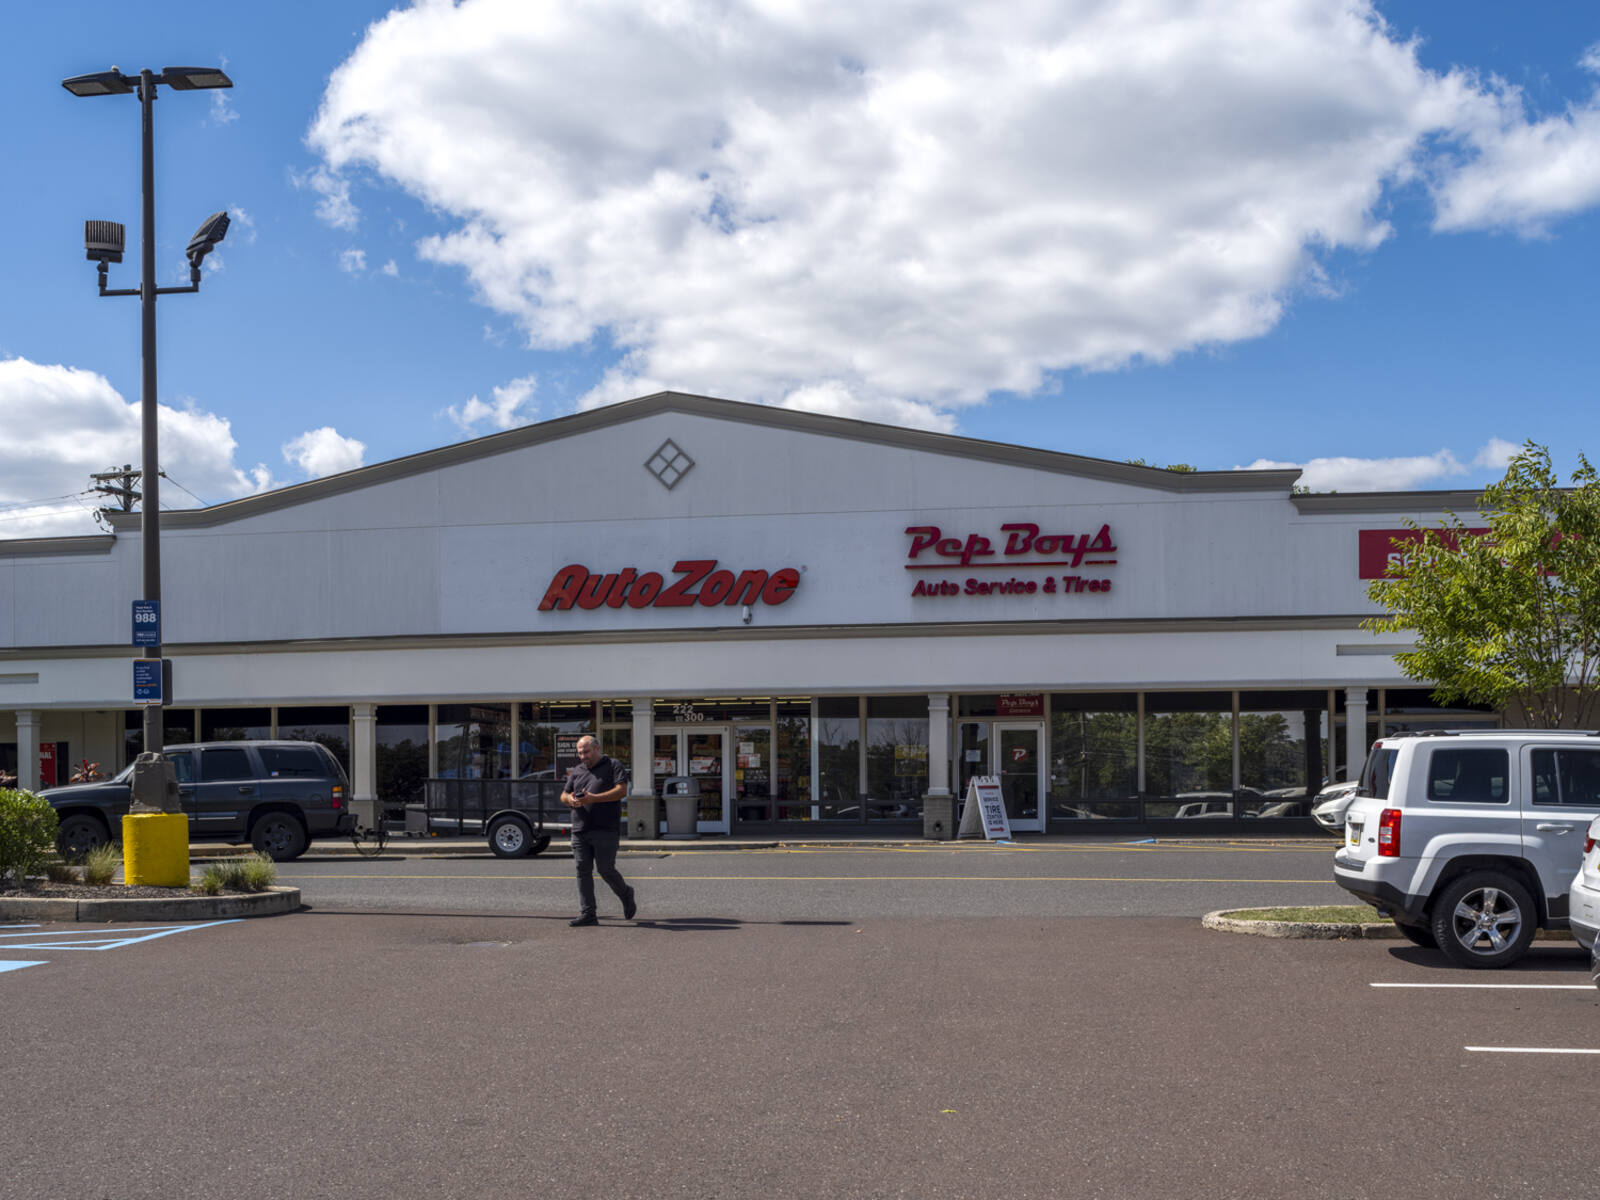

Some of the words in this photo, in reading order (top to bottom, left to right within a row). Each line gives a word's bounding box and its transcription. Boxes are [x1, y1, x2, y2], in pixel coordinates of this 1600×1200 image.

[904, 526, 996, 566] Pep
[1000, 523, 1118, 568] Boys
[537, 560, 800, 611] AutoZone
[911, 579, 960, 597] Auto
[963, 577, 1037, 596] Service
[1042, 576, 1057, 594] &
[1062, 576, 1112, 593] Tires
[135, 613, 157, 623] 988
[673, 705, 694, 714] 222
[684, 712, 704, 722] 300
[985, 805, 1001, 814] TIRE
